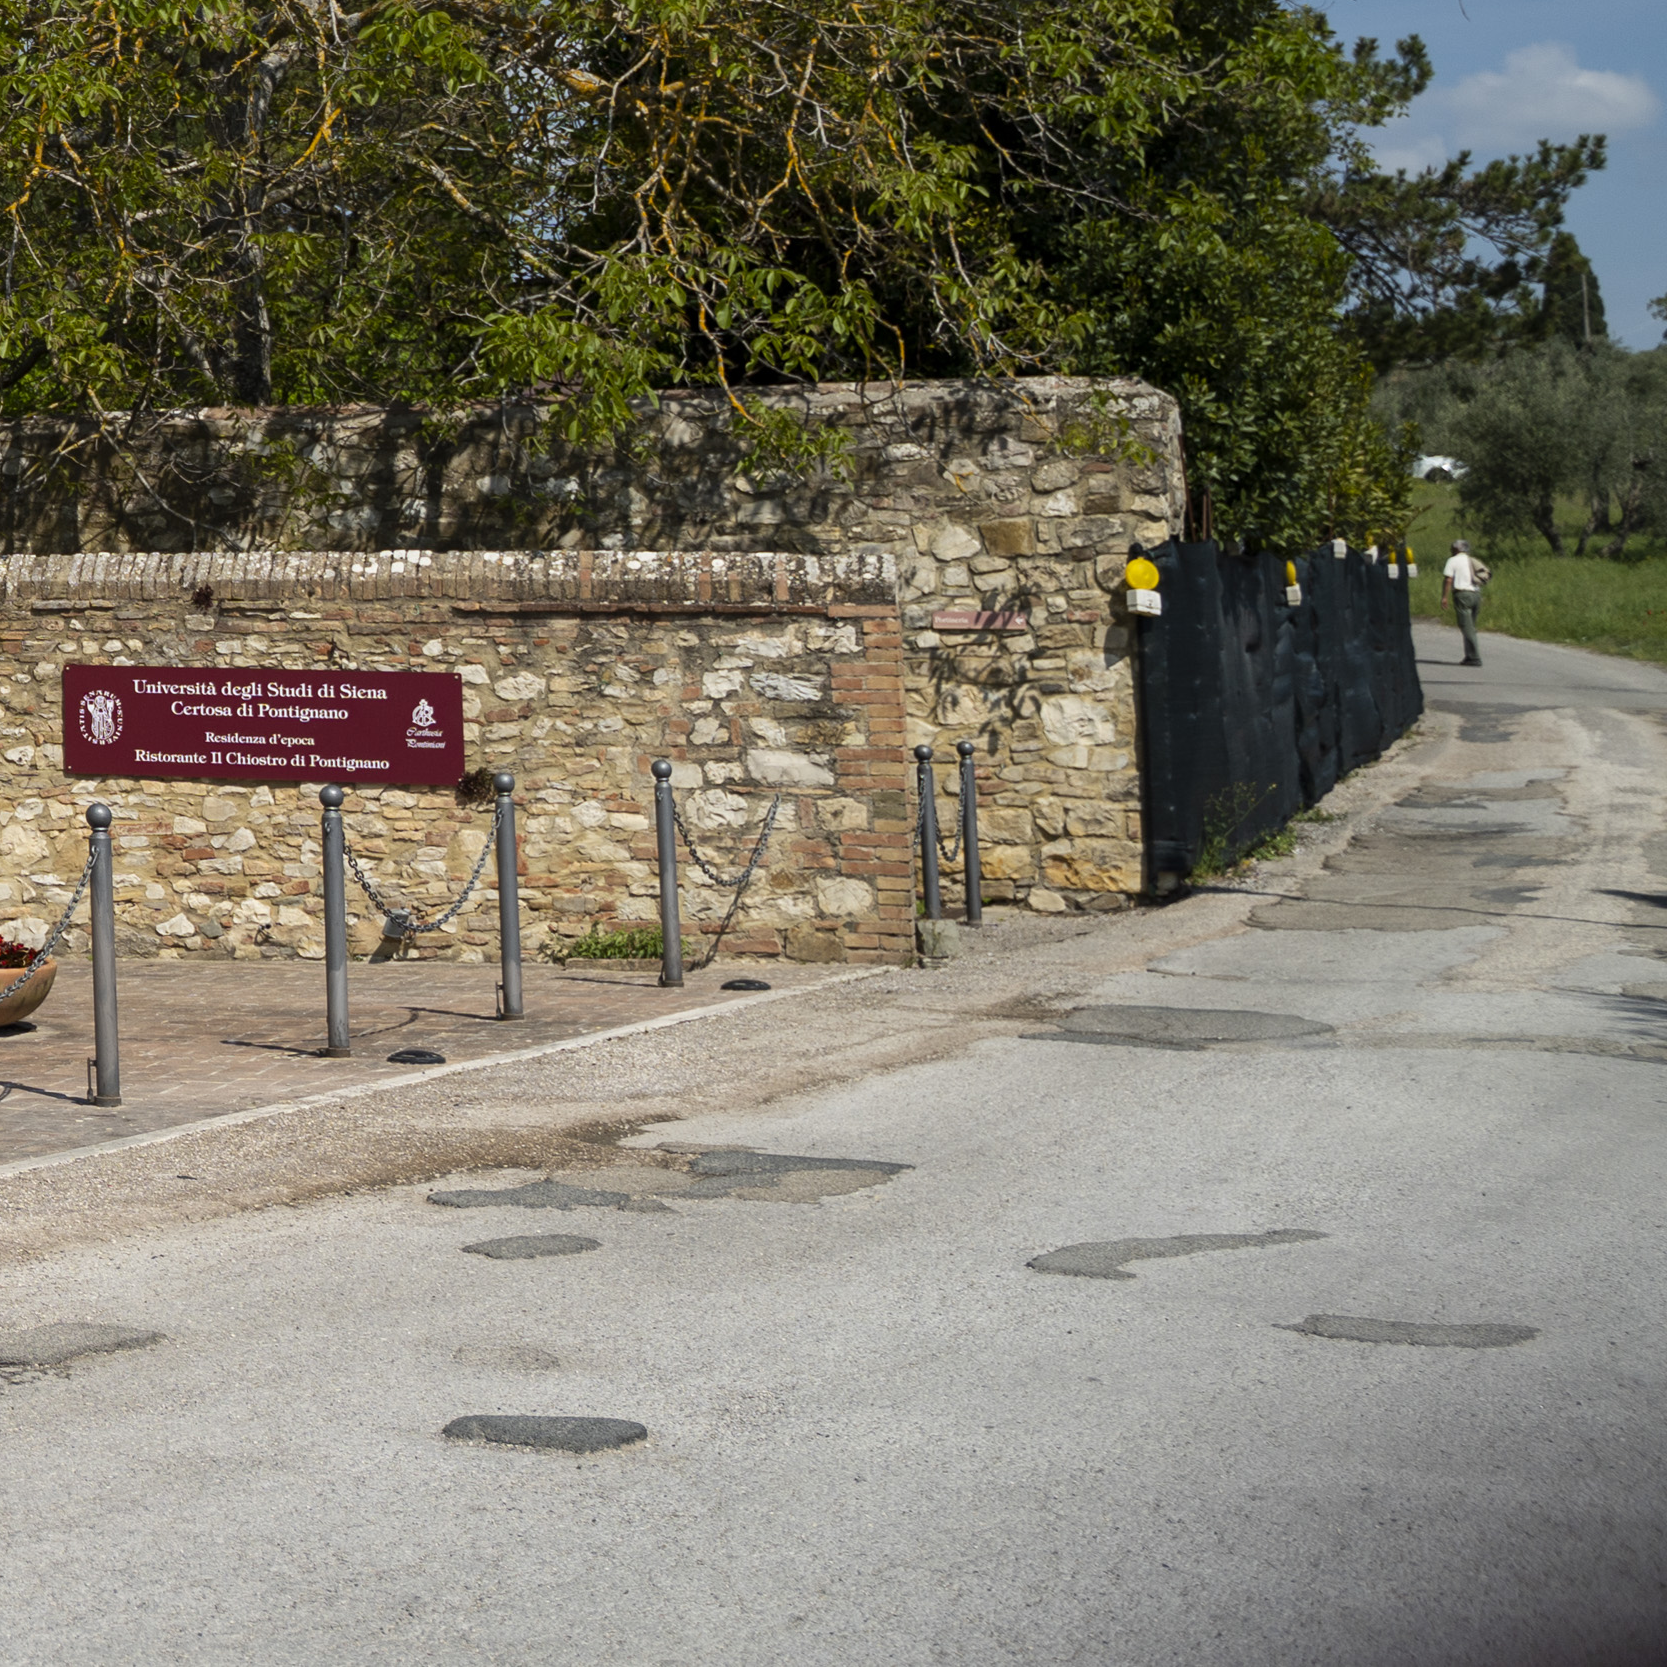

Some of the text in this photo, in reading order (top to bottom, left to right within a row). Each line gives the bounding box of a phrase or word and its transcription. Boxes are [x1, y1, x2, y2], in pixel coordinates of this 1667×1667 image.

[132, 679, 388, 701] Università degli Studi di Siena
[171, 700, 349, 723] Certosa di Pontignano
[205, 731, 266, 745] Residenza
[134, 749, 390, 772] Ristorante Il Chiostro di Pontignano
